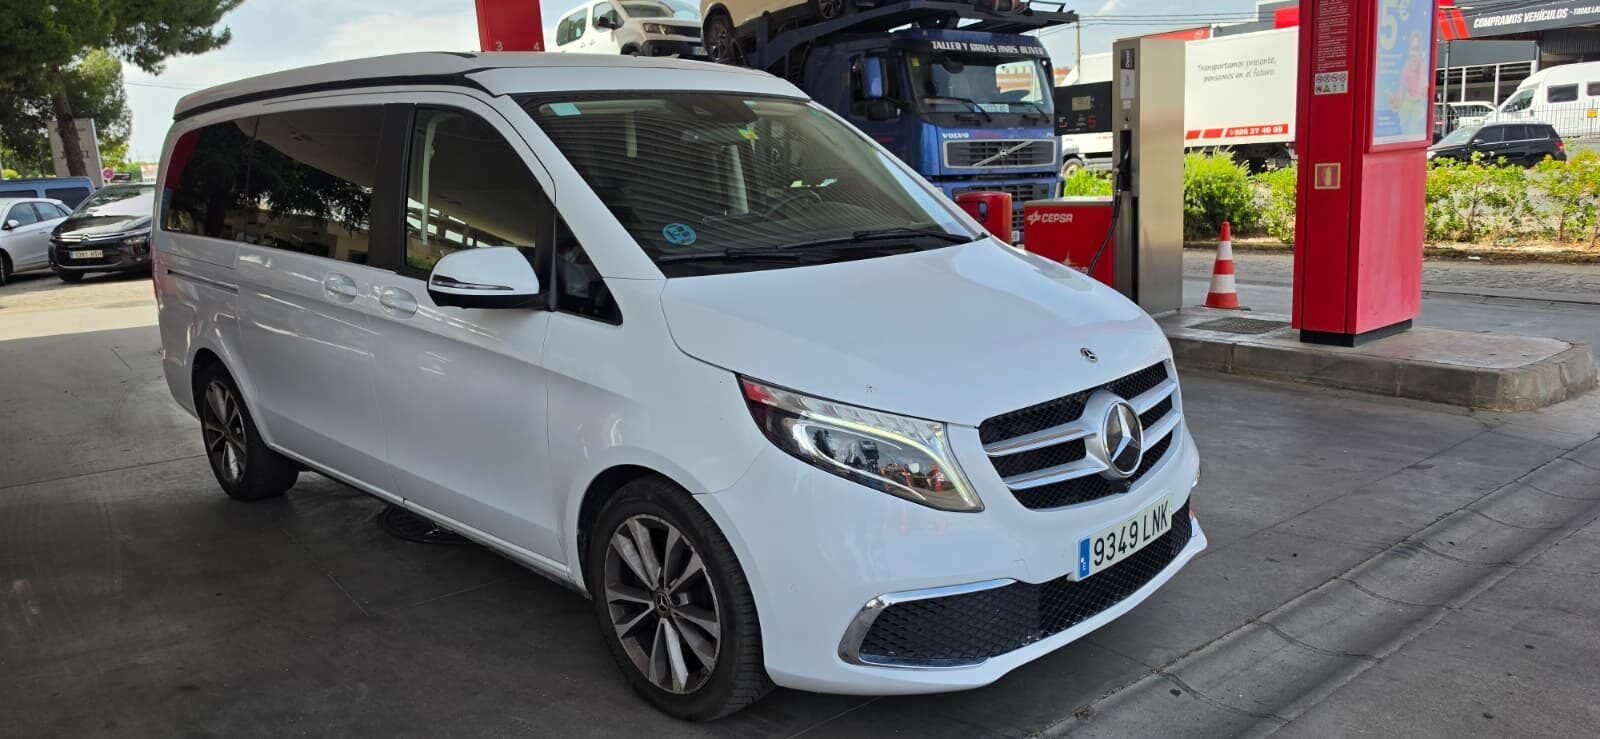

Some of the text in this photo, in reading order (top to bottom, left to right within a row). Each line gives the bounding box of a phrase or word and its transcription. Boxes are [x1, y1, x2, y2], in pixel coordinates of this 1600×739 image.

[1473, 13, 1523, 28] COMPRAMOS
[1523, 8, 1569, 23] VEHÍCULOS
[1041, 213, 1073, 223] CEPSA
[1093, 500, 1169, 566] 9349 LNK
